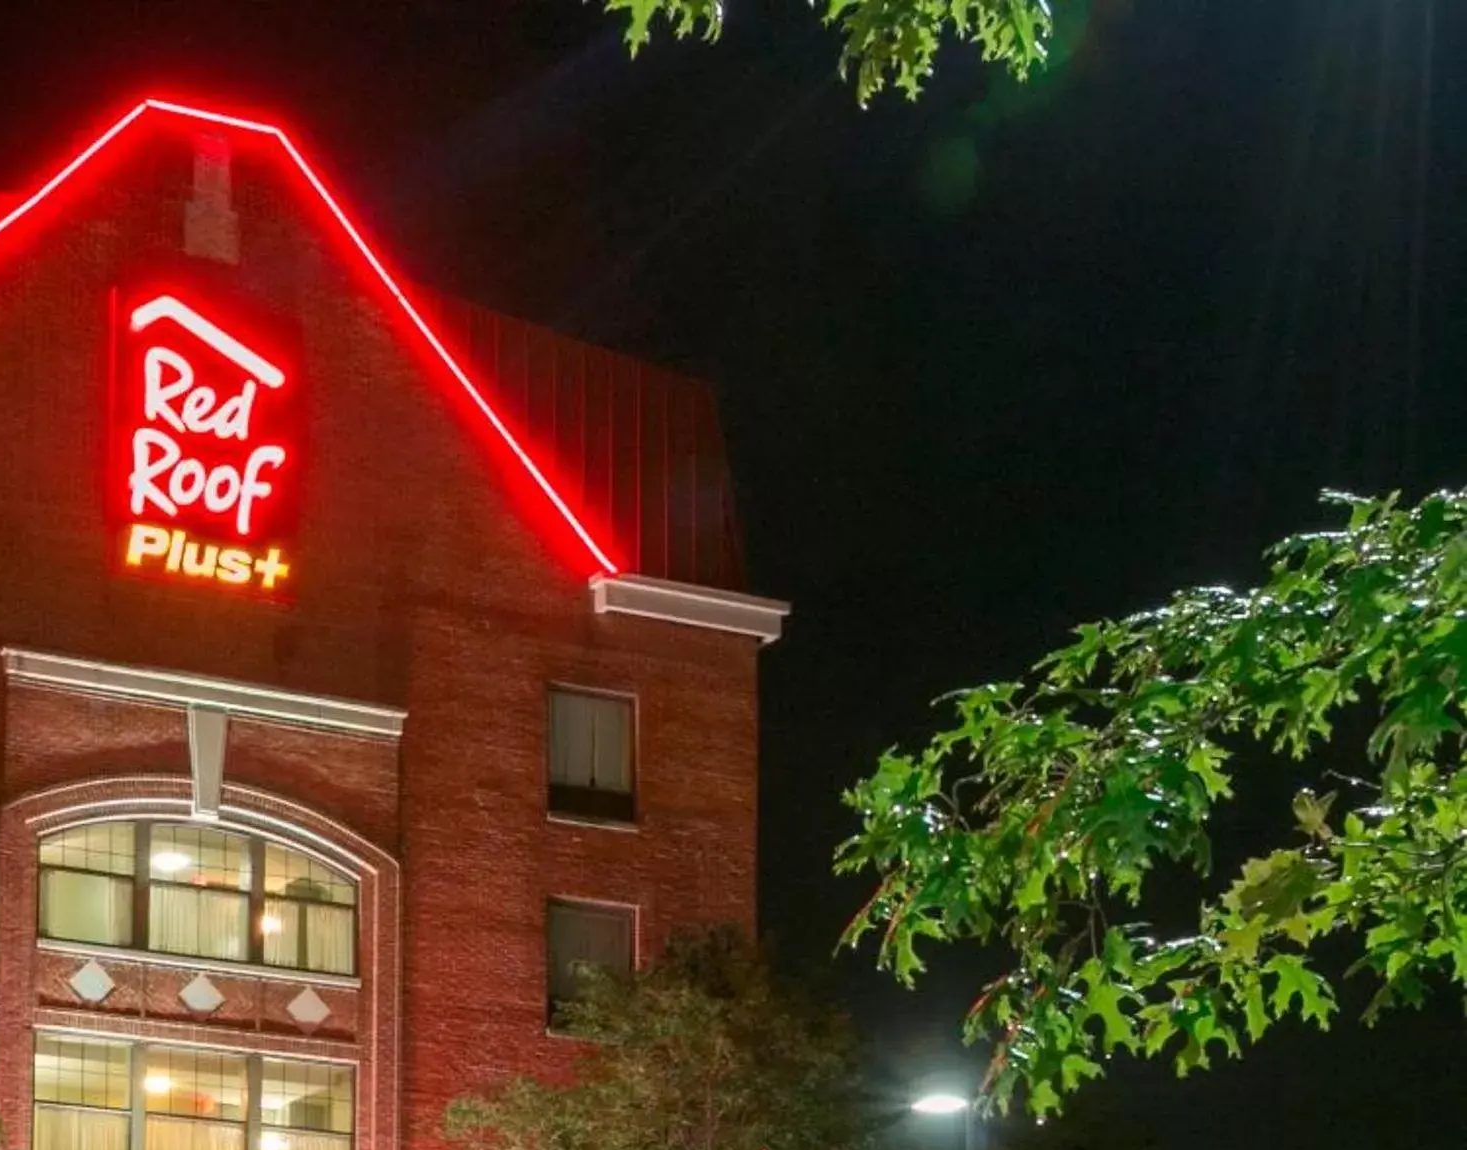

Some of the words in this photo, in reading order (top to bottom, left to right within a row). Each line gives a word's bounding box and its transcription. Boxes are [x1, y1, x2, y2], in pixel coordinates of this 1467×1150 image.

[144, 346, 256, 440] Red
[129, 428, 286, 536] Roof
[126, 523, 289, 588] Plus+
